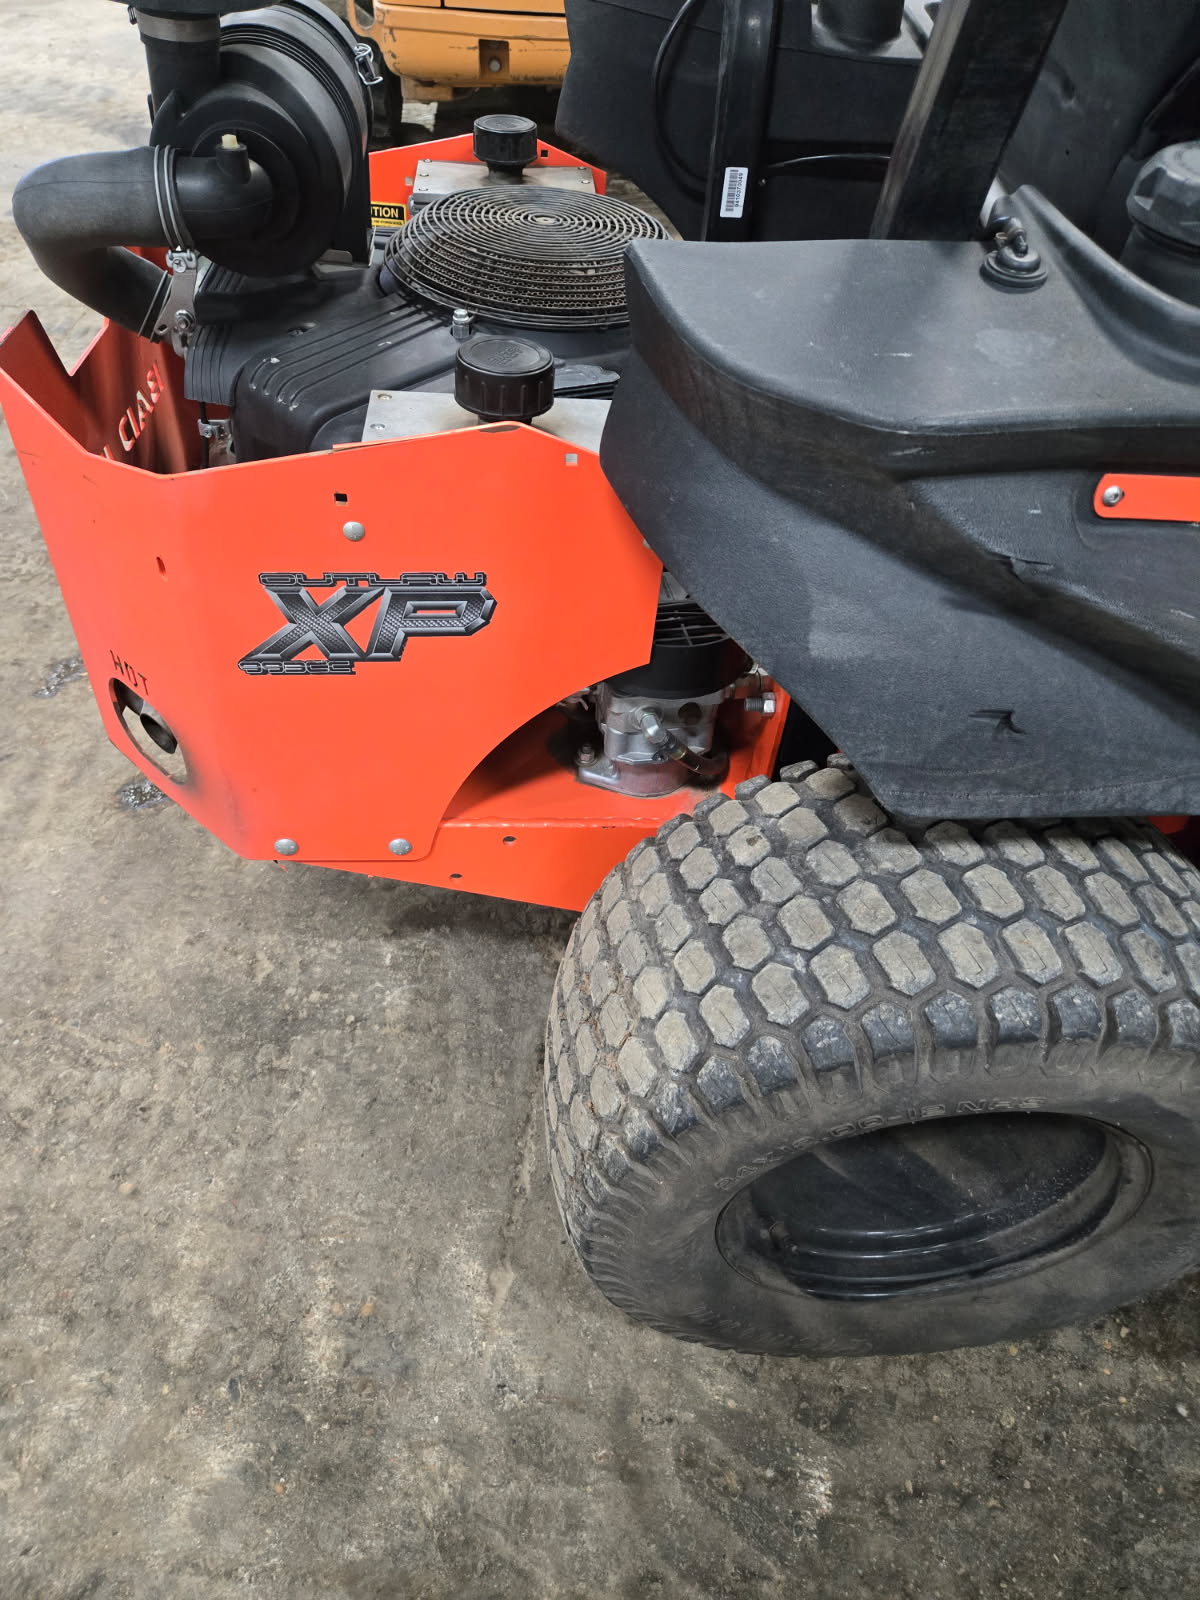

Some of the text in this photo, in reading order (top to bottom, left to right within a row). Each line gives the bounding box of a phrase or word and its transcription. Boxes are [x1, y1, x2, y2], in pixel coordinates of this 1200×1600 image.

[371, 206, 398, 218] TION
[258, 572, 487, 586] OUTLAW
[238, 585, 498, 662] XP
[109, 649, 149, 696] HOT
